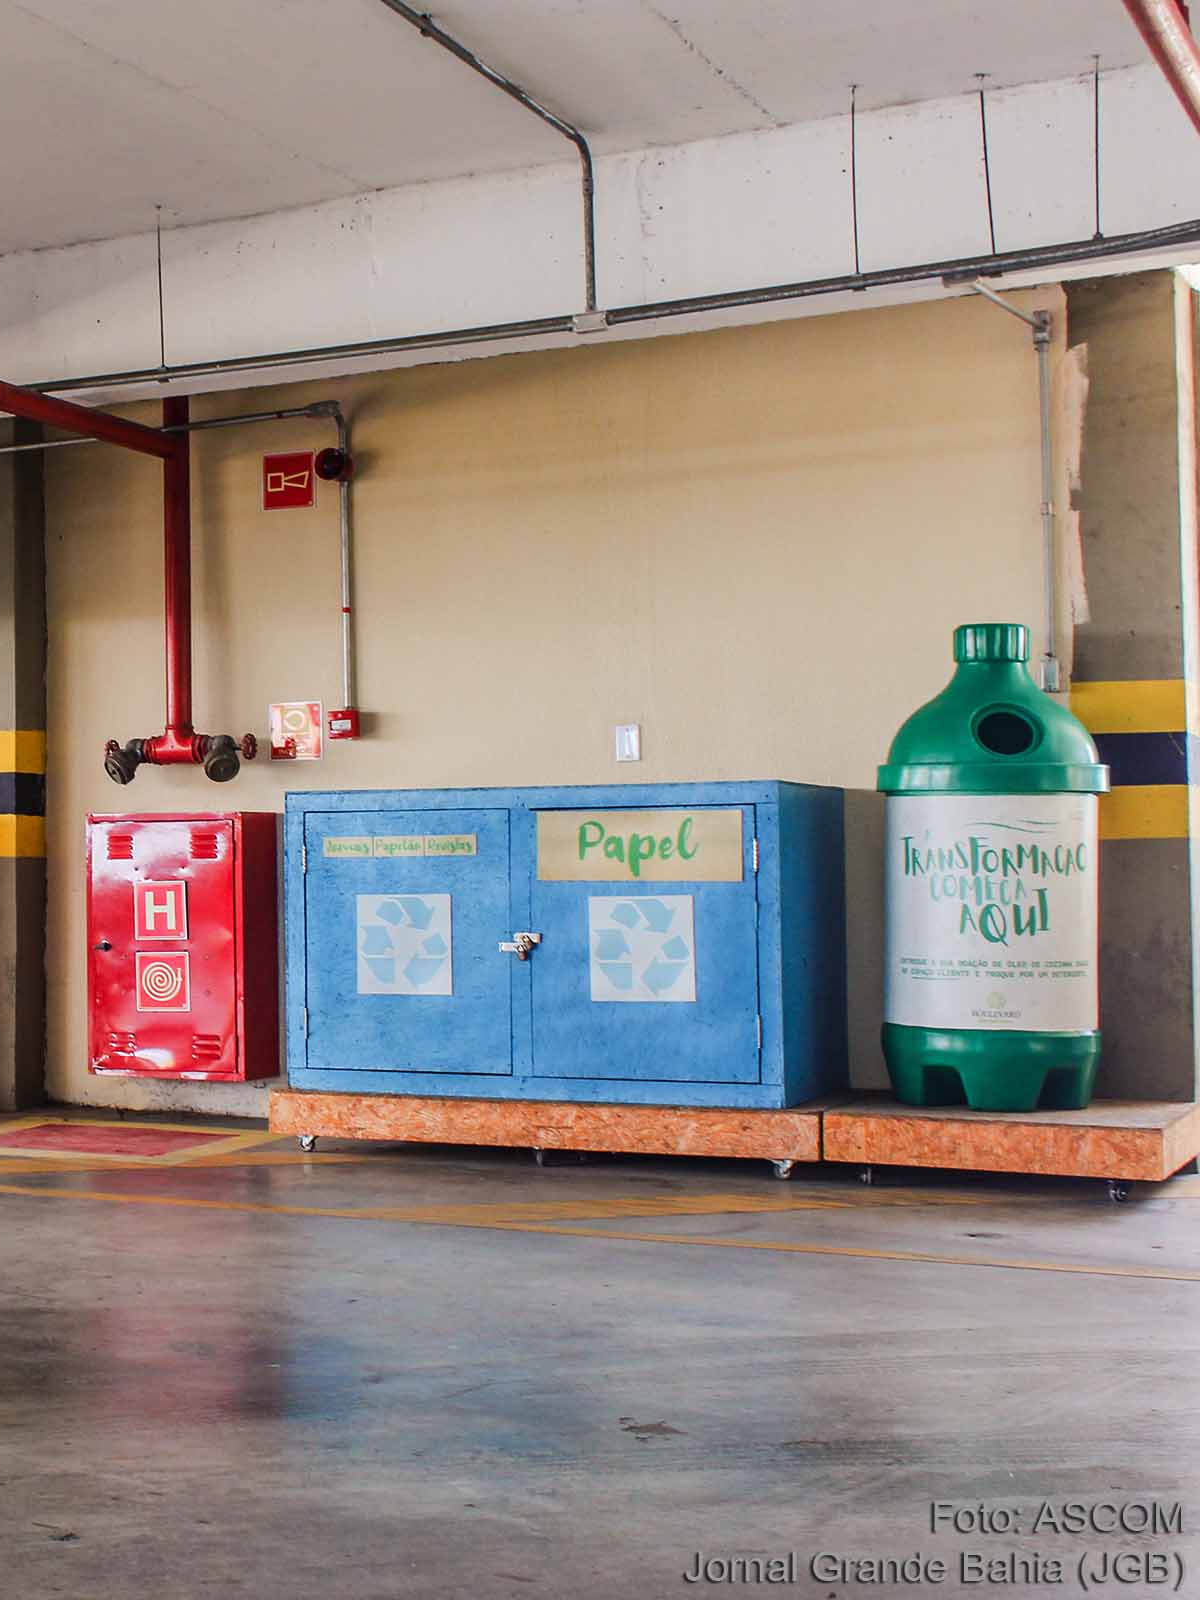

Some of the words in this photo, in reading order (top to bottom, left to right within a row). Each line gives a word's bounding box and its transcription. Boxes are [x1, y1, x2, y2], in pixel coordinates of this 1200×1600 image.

[578, 817, 700, 877] Papel
[144, 890, 176, 931] H
[959, 888, 1051, 947] AQUI
